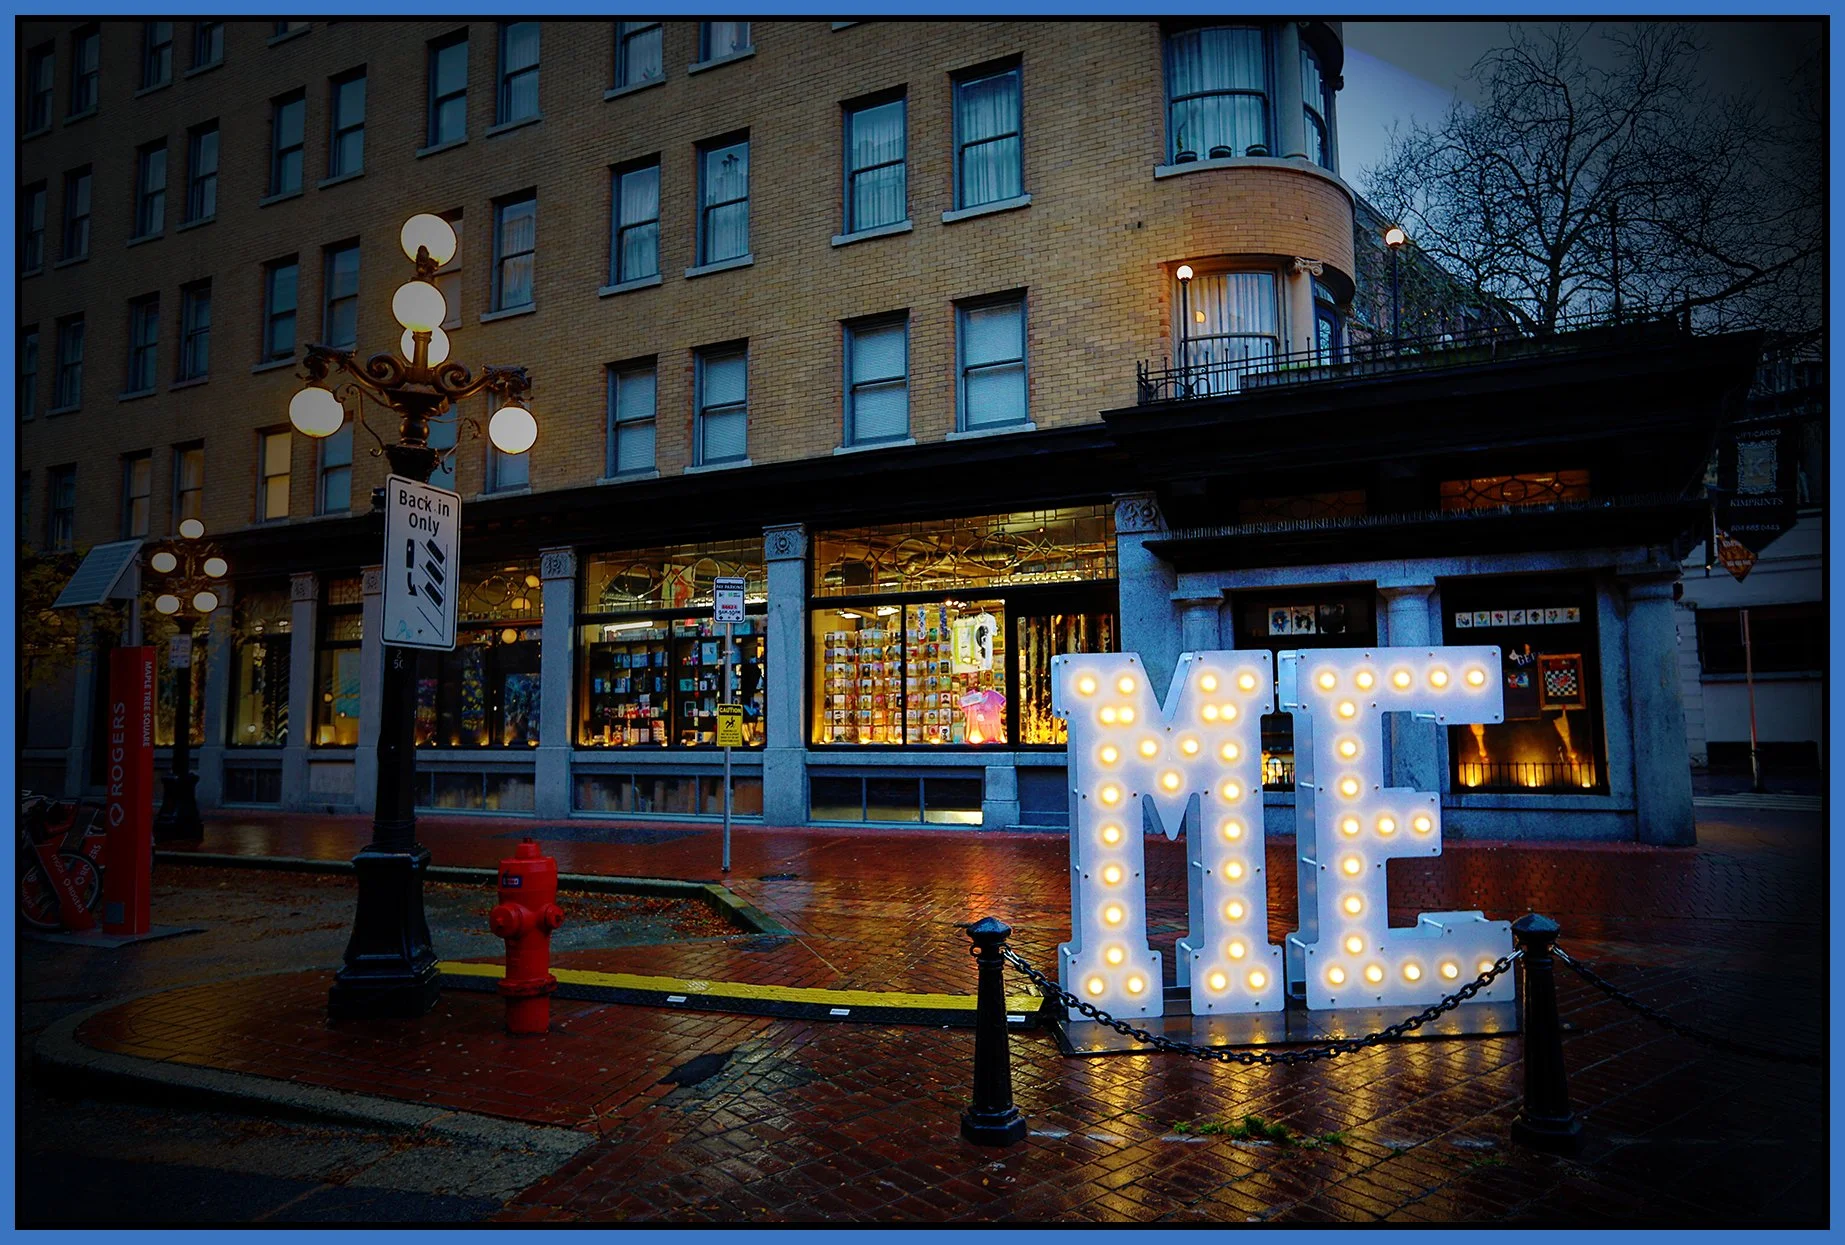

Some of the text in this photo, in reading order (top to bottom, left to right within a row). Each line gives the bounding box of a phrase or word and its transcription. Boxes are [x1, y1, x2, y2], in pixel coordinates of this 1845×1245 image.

[399, 489, 450, 517] Back in
[1729, 497, 1784, 507] KIMPRINTS
[408, 512, 440, 537] Only
[142, 661, 153, 748] MAPLE TREE SQUARE
[719, 706, 742, 714] CAUTION
[110, 701, 126, 797] ROGERS
[1051, 645, 1516, 1021] ME
[67, 885, 85, 914] ROGERS
